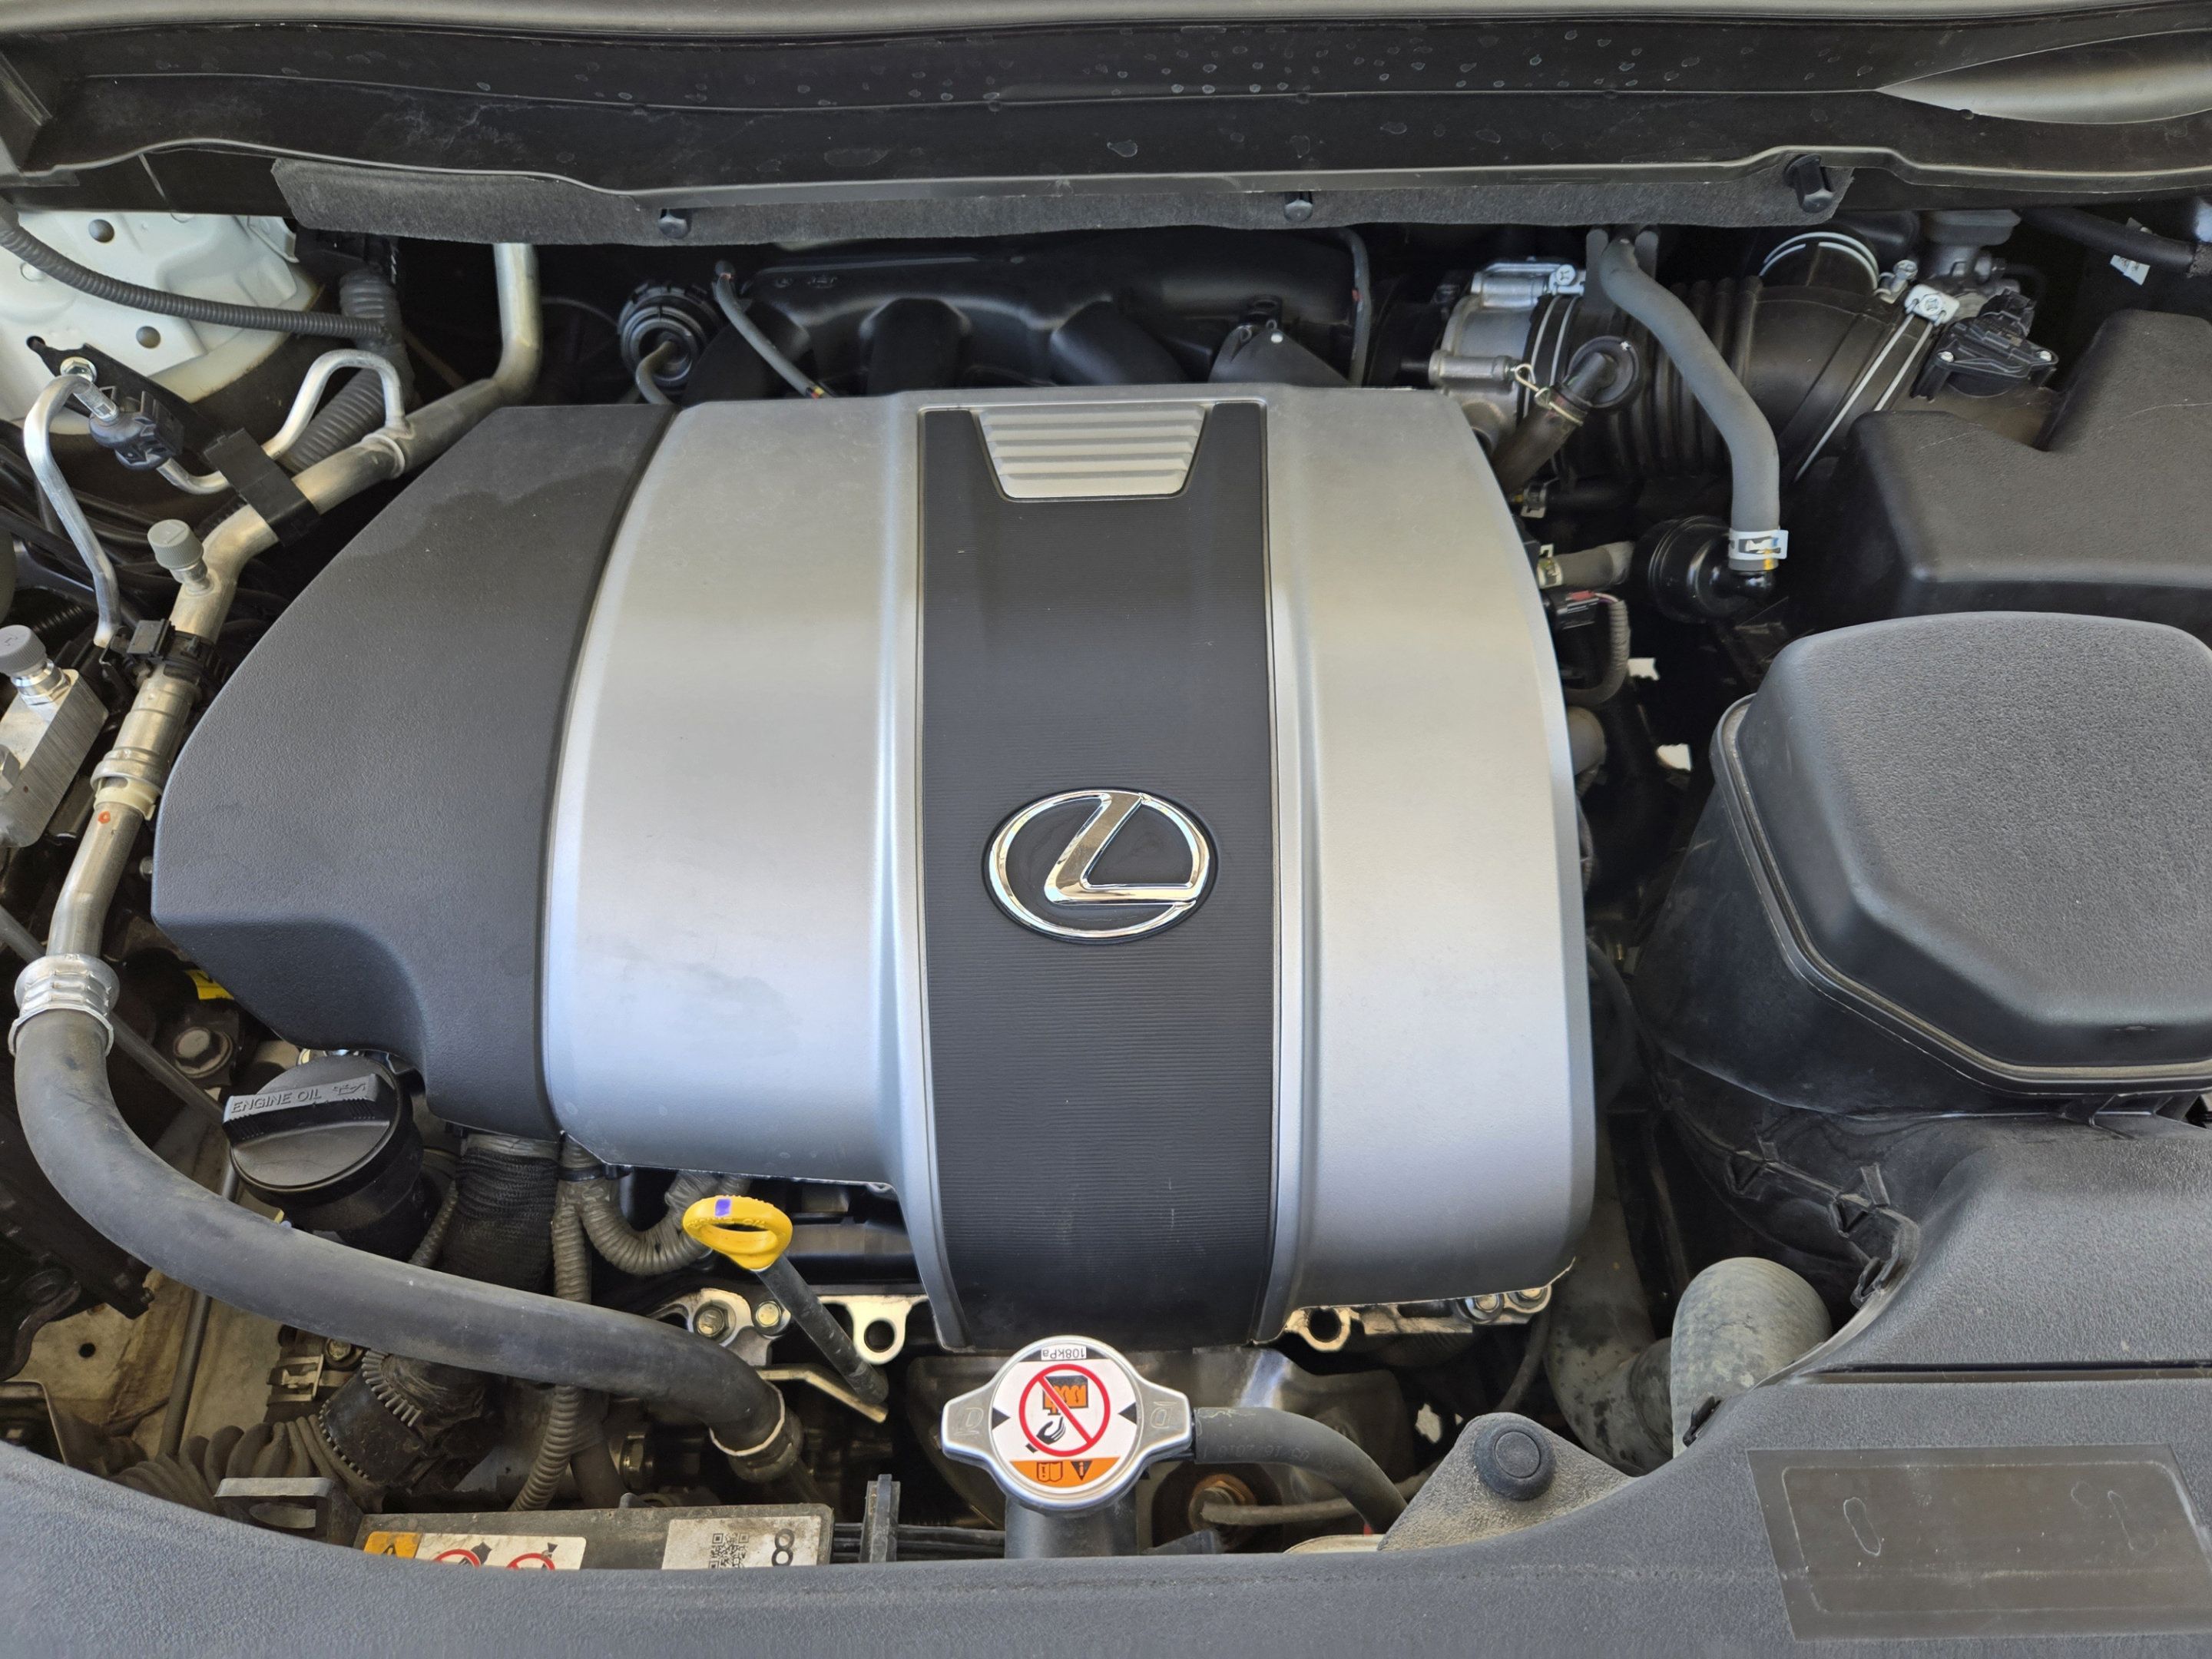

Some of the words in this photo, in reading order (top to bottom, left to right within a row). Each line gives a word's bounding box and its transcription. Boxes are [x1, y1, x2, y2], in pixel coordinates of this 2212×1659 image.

[231, 1092, 293, 1114] ENGINE
[297, 1088, 322, 1102] OIL
[1041, 1348, 1086, 1359] 108kPa
[771, 1528, 795, 1567] 8
